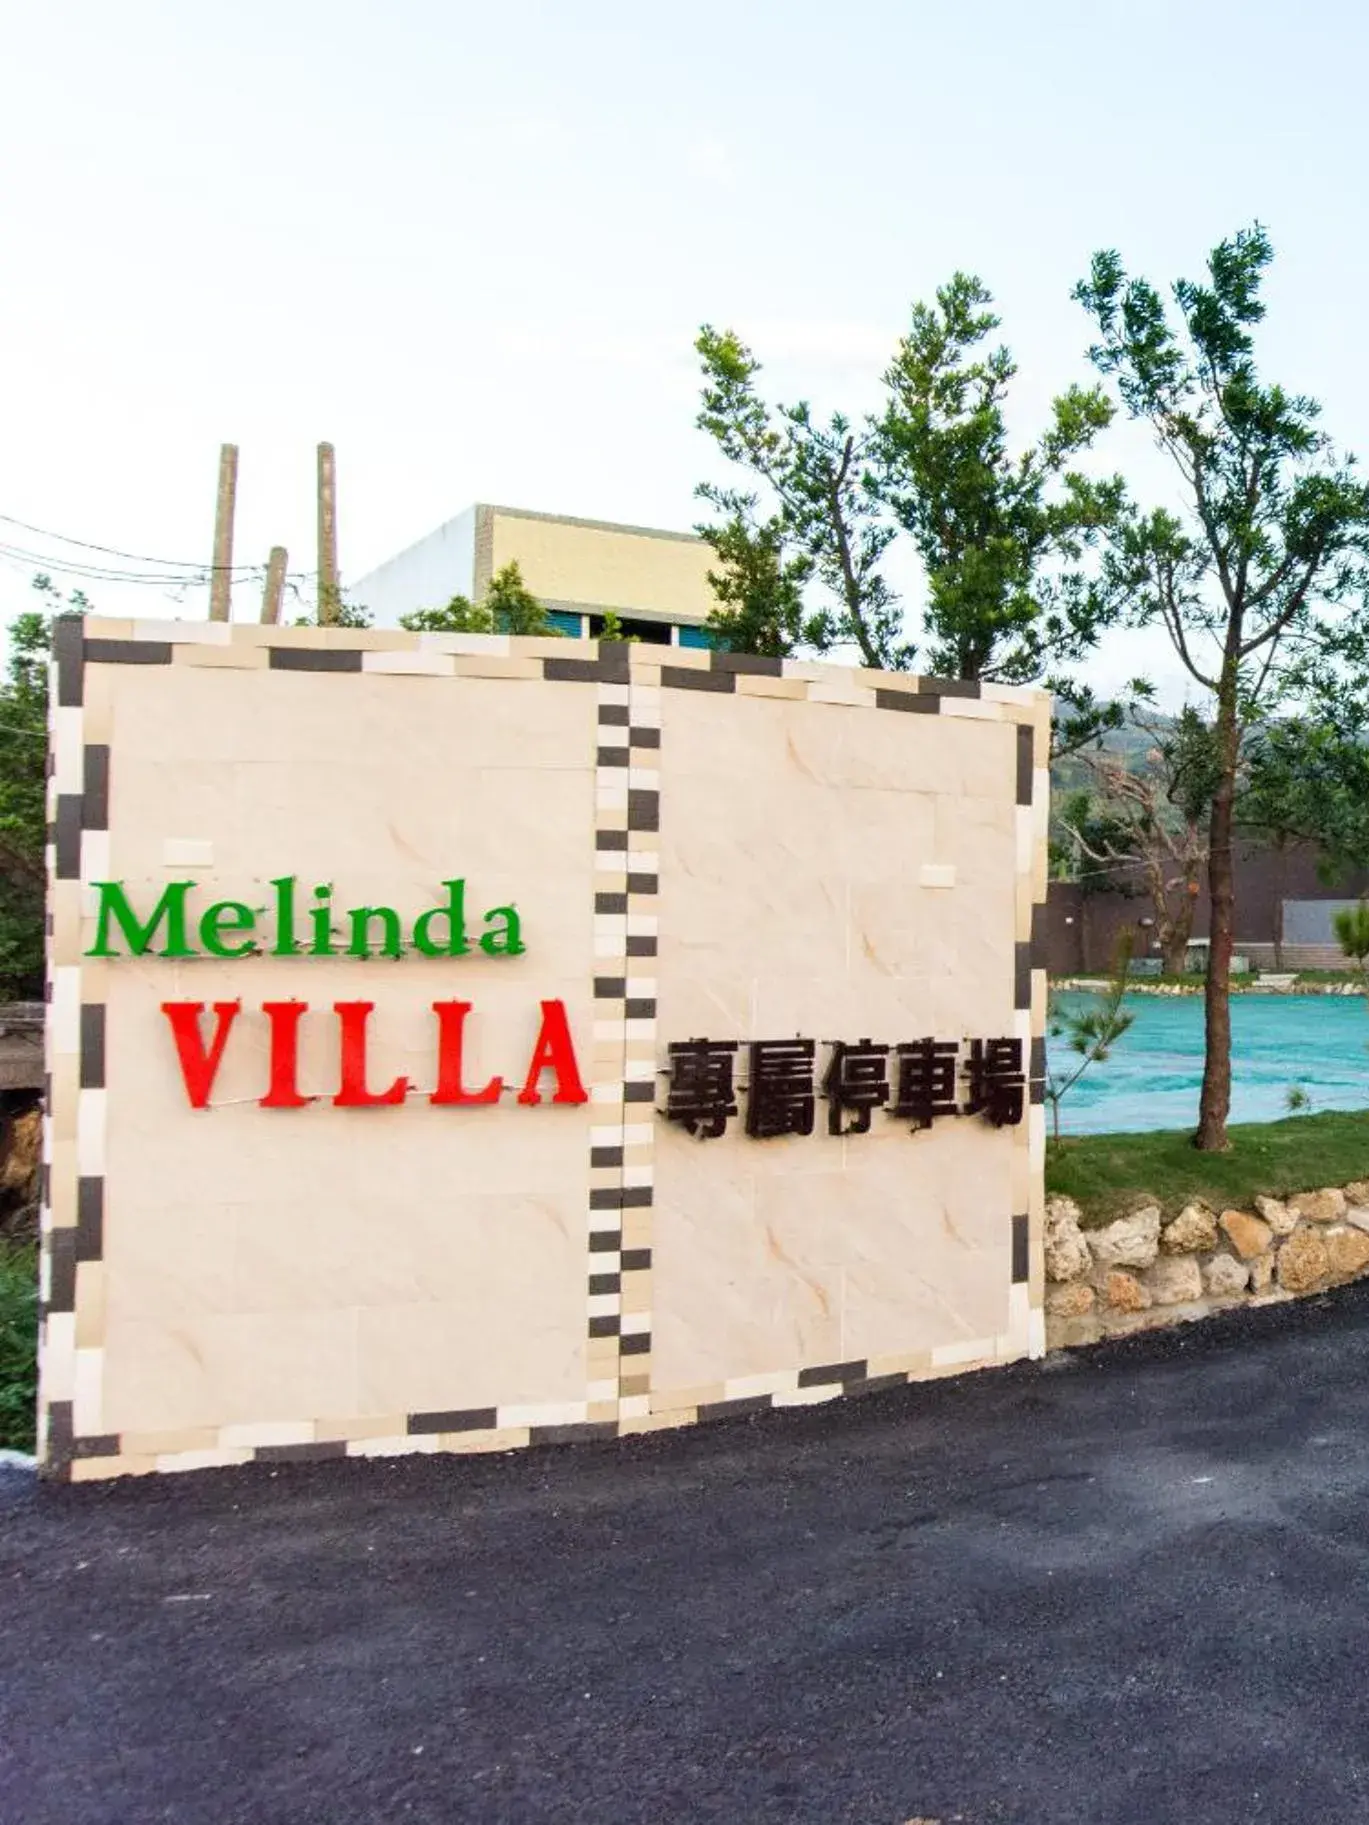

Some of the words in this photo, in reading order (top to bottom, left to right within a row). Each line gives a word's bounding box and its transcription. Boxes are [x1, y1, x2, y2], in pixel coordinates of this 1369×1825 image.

[84, 876, 526, 958] Melinda
[161, 1000, 588, 1109] VILLA
[667, 1037, 1025, 1138] 專屬停車場
